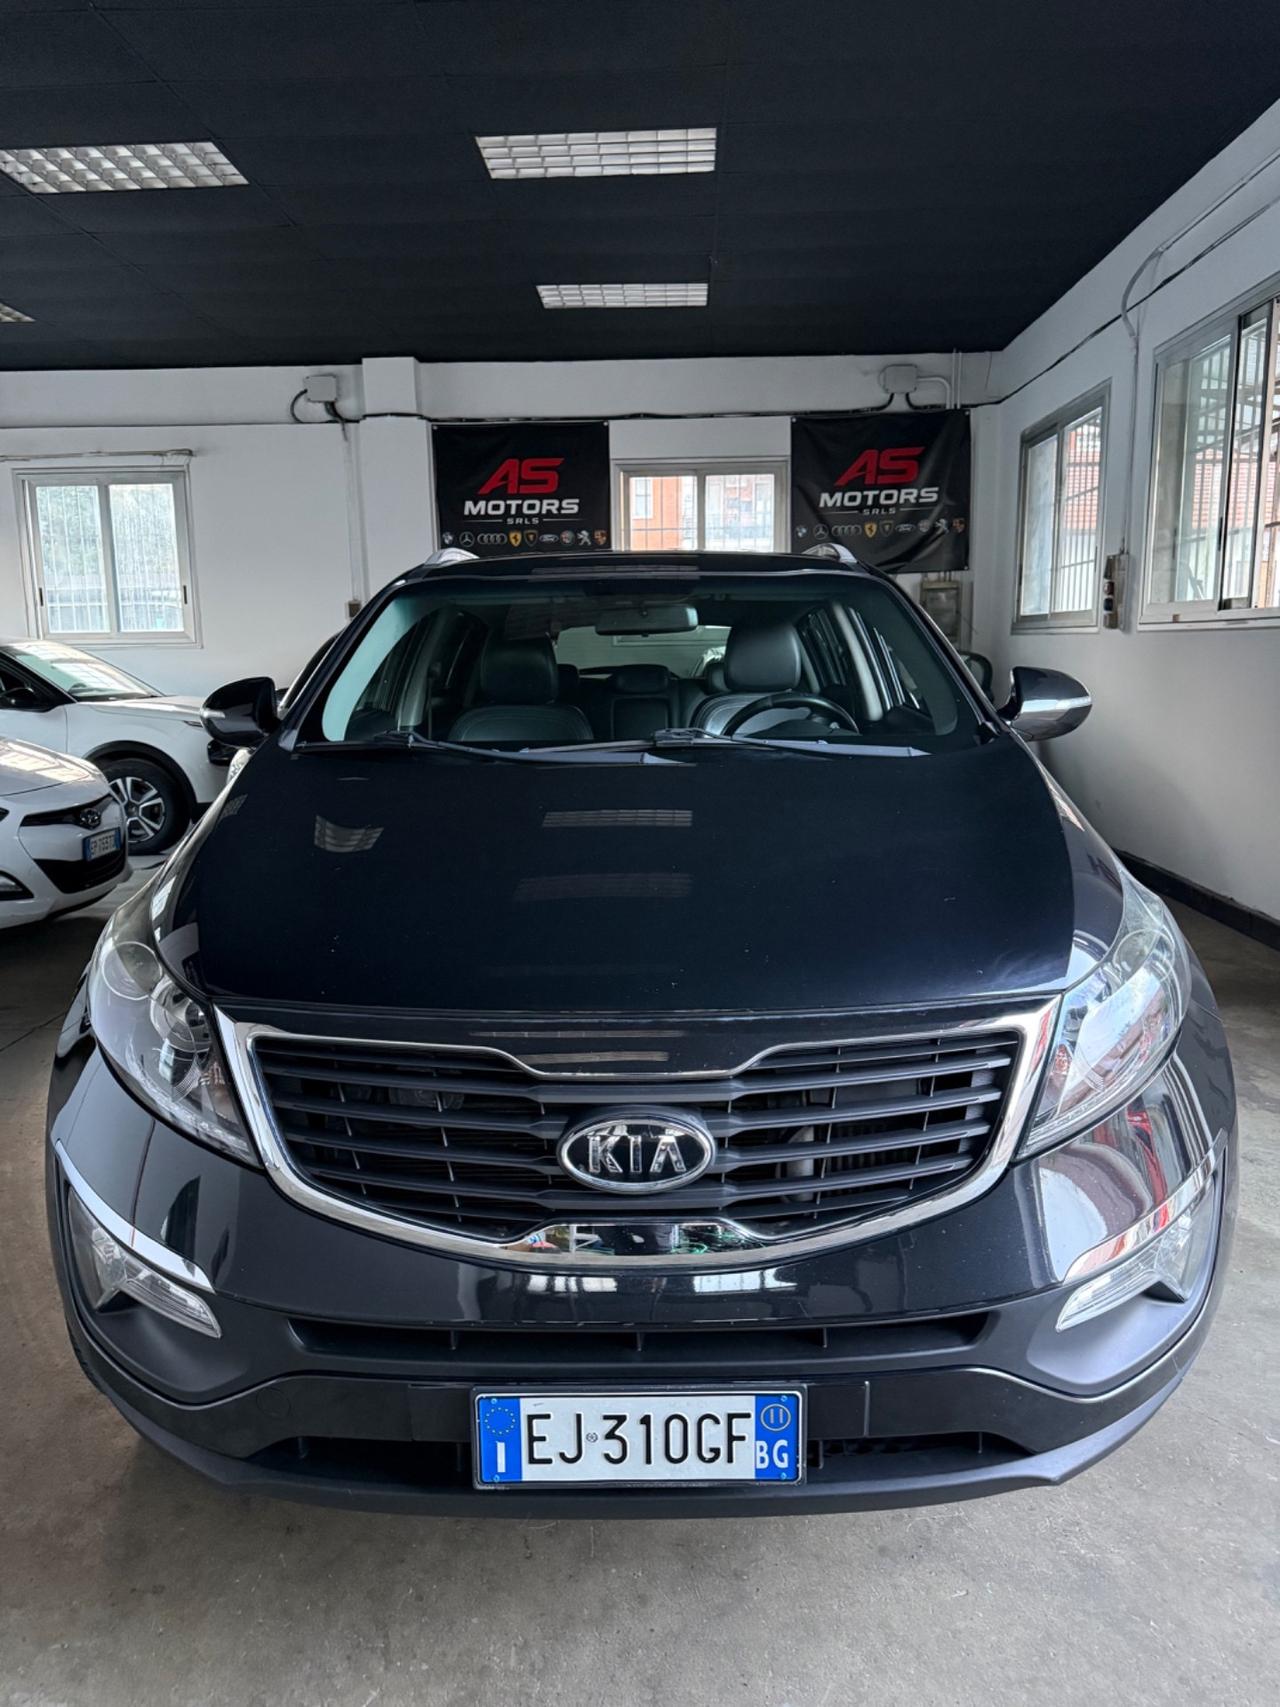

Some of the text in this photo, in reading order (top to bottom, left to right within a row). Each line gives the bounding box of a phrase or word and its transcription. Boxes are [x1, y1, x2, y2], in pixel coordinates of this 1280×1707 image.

[477, 457, 565, 495] AS
[834, 447, 925, 486] AS
[463, 498, 580, 516] MOTORS
[819, 487, 939, 508] MOTORS
[862, 507, 897, 516] SRLS
[506, 517, 540, 525] SRLS
[587, 1134, 687, 1173] KIA
[526, 1411, 752, 1465] EJ 310GF
[755, 1439, 790, 1469] BG
